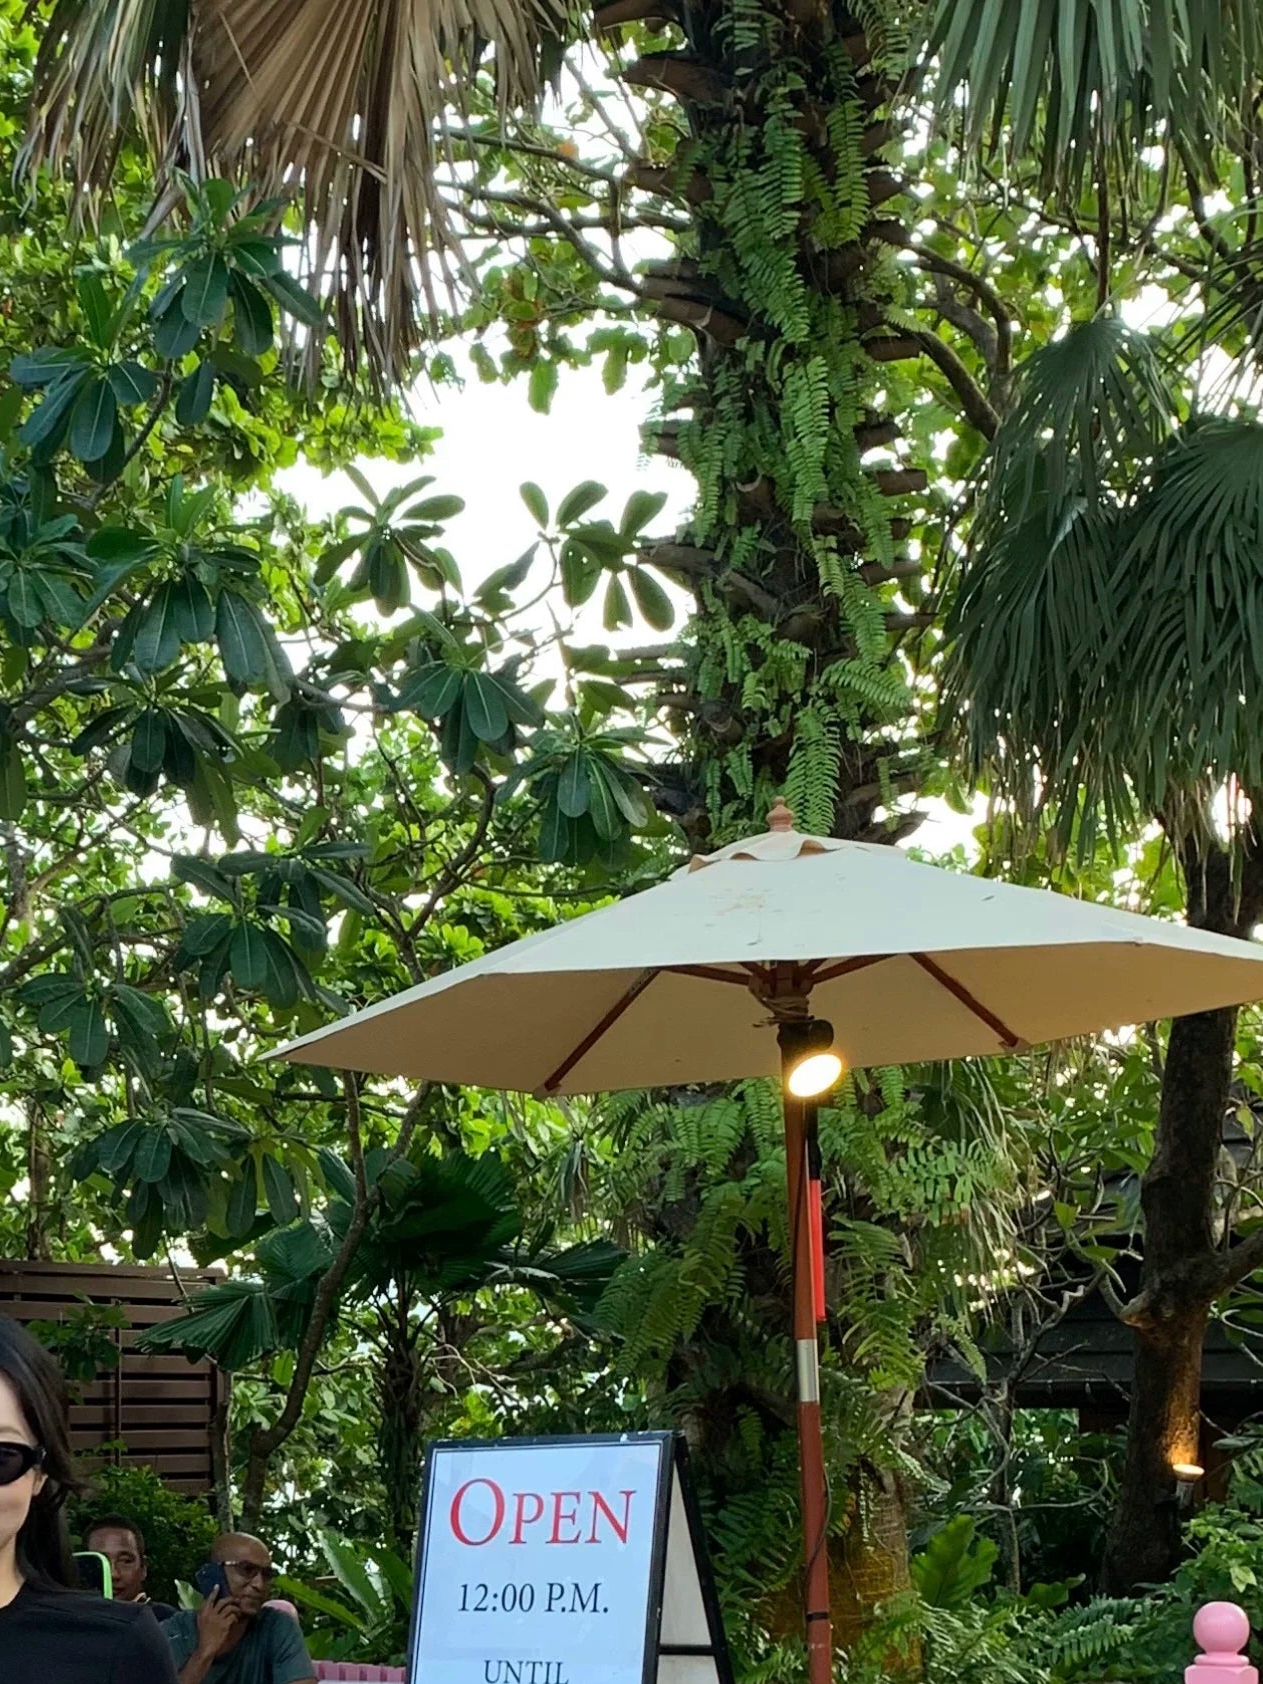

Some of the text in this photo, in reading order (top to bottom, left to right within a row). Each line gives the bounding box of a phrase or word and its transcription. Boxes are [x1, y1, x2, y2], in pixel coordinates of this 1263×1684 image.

[449, 1477, 637, 1546] OPEN
[457, 1582, 609, 1614] 12:00 P.M.
